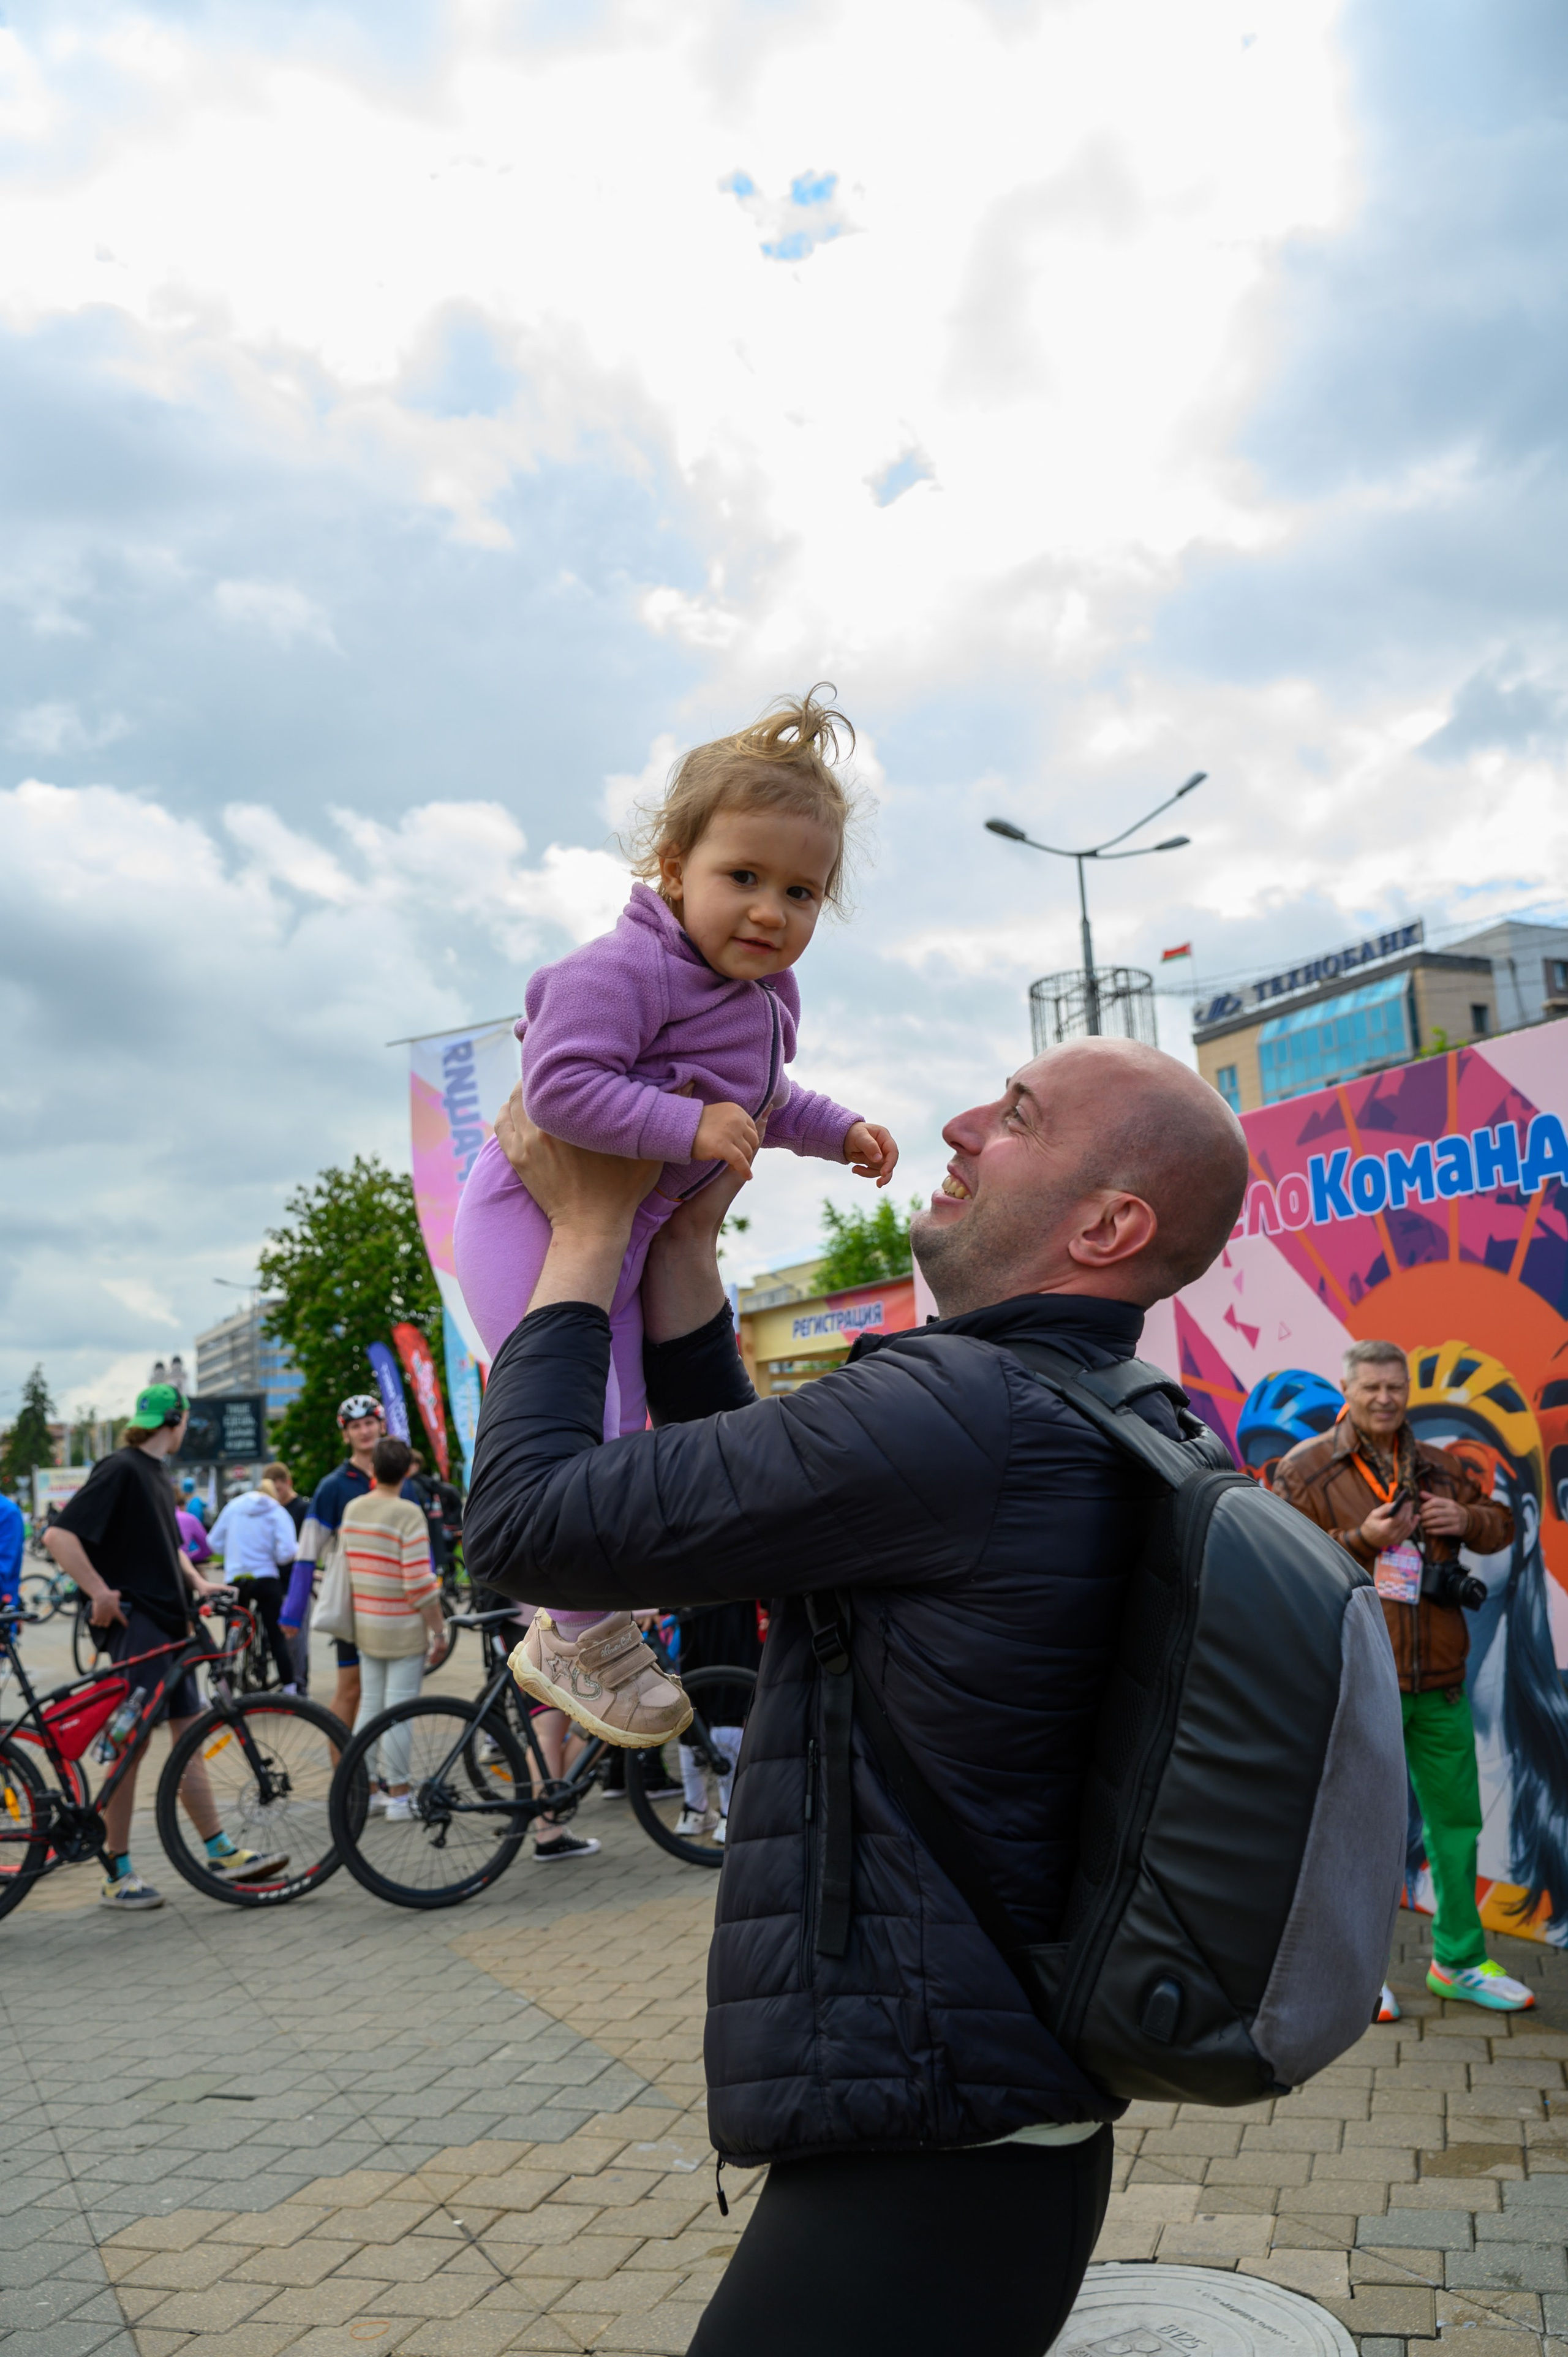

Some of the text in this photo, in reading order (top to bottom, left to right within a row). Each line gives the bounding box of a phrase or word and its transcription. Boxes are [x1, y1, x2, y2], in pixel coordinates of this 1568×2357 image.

[1253, 922, 1420, 1002] ТЕХНОБАНК
[793, 1301, 884, 1340] РЕГИСТРАЦИЯ
[1156, 2324, 1207, 2349] B125
